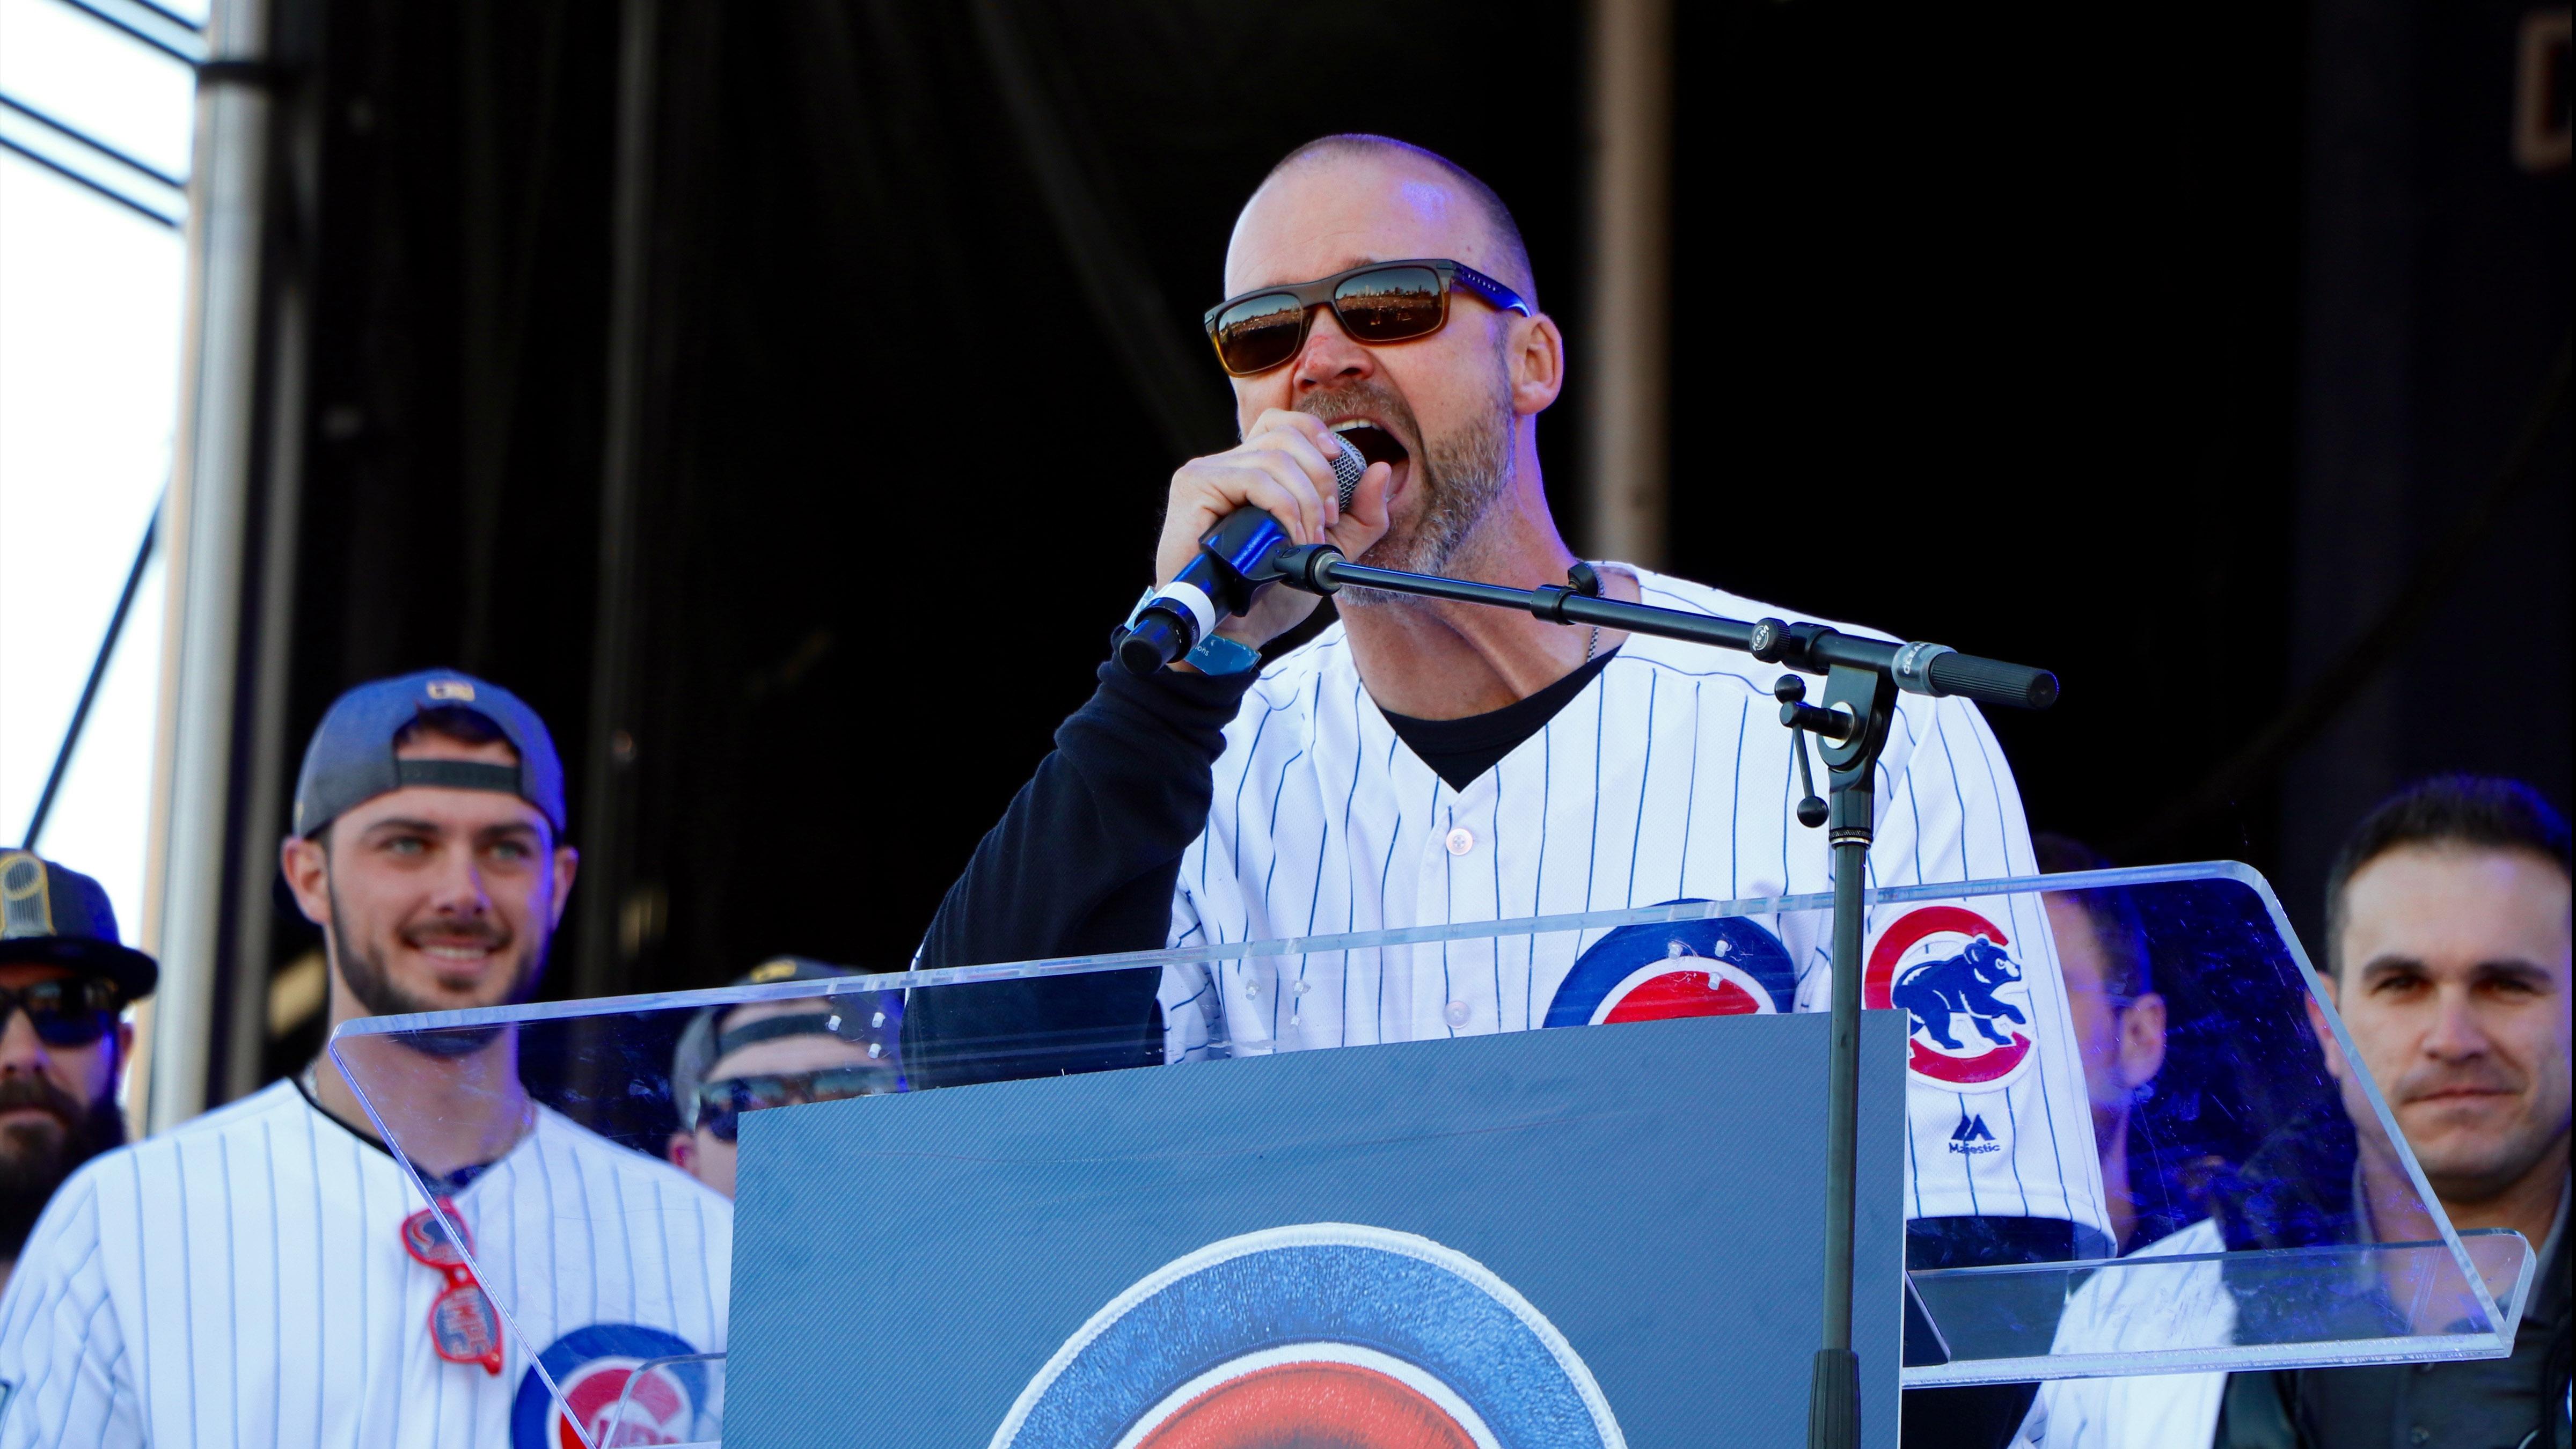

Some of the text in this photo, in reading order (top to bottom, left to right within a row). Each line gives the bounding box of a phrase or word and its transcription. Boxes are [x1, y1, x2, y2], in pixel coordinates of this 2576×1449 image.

[1752, 625, 1769, 651] K&M
[1195, 646, 1210, 656] ons
[1949, 1142, 2001, 1154] Majestic
